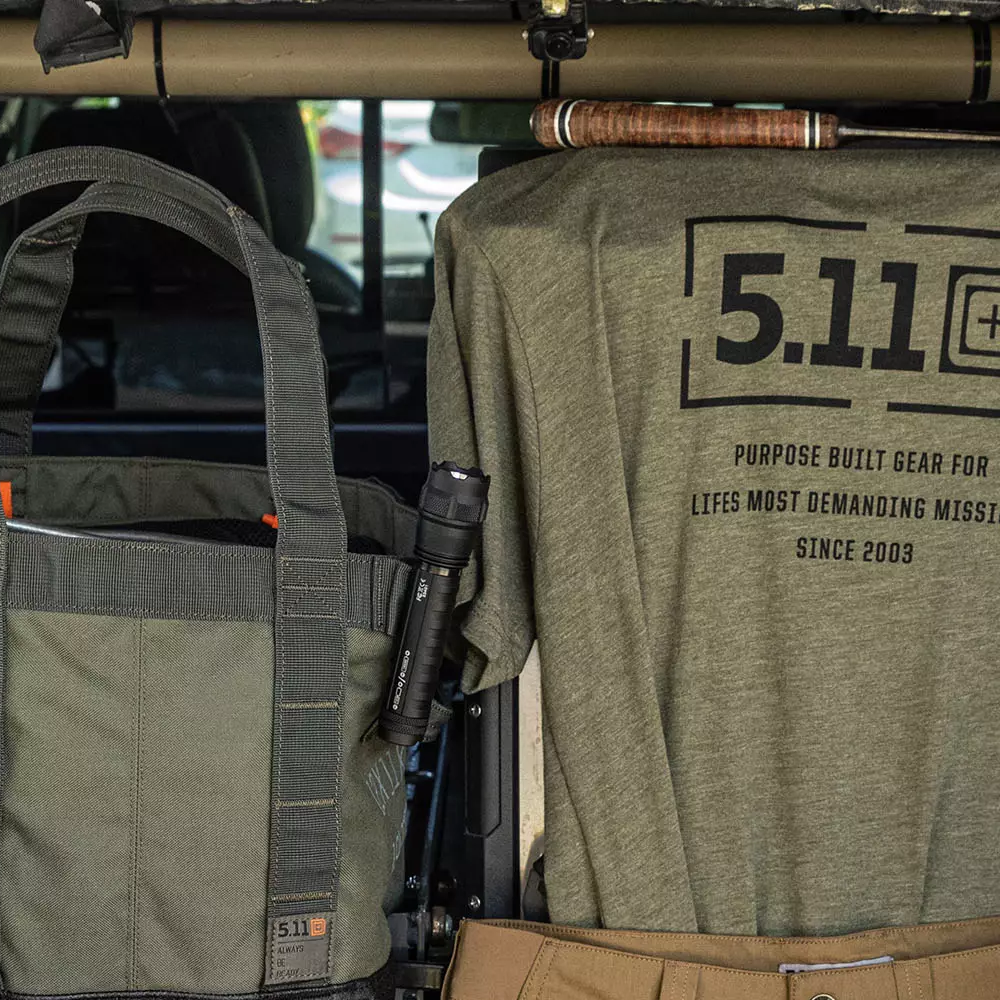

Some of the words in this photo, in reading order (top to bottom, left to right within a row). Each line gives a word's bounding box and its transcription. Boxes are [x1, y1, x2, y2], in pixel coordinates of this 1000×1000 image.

[715, 252, 926, 372] 5.11
[734, 443, 822, 467] PURPOSE
[828, 446, 886, 471] BUILT
[893, 450, 943, 474] GEAR
[951, 454, 989, 477] FOR
[691, 491, 740, 516] LIFES
[747, 489, 801, 513] MOST
[807, 491, 926, 520] DEMANDING
[933, 498, 1000, 525] MISSI
[796, 536, 856, 562] SINCE
[862, 540, 914, 564] 2003
[277, 919, 310, 938] 5.11
[277, 944, 304, 955] ALWAYS
